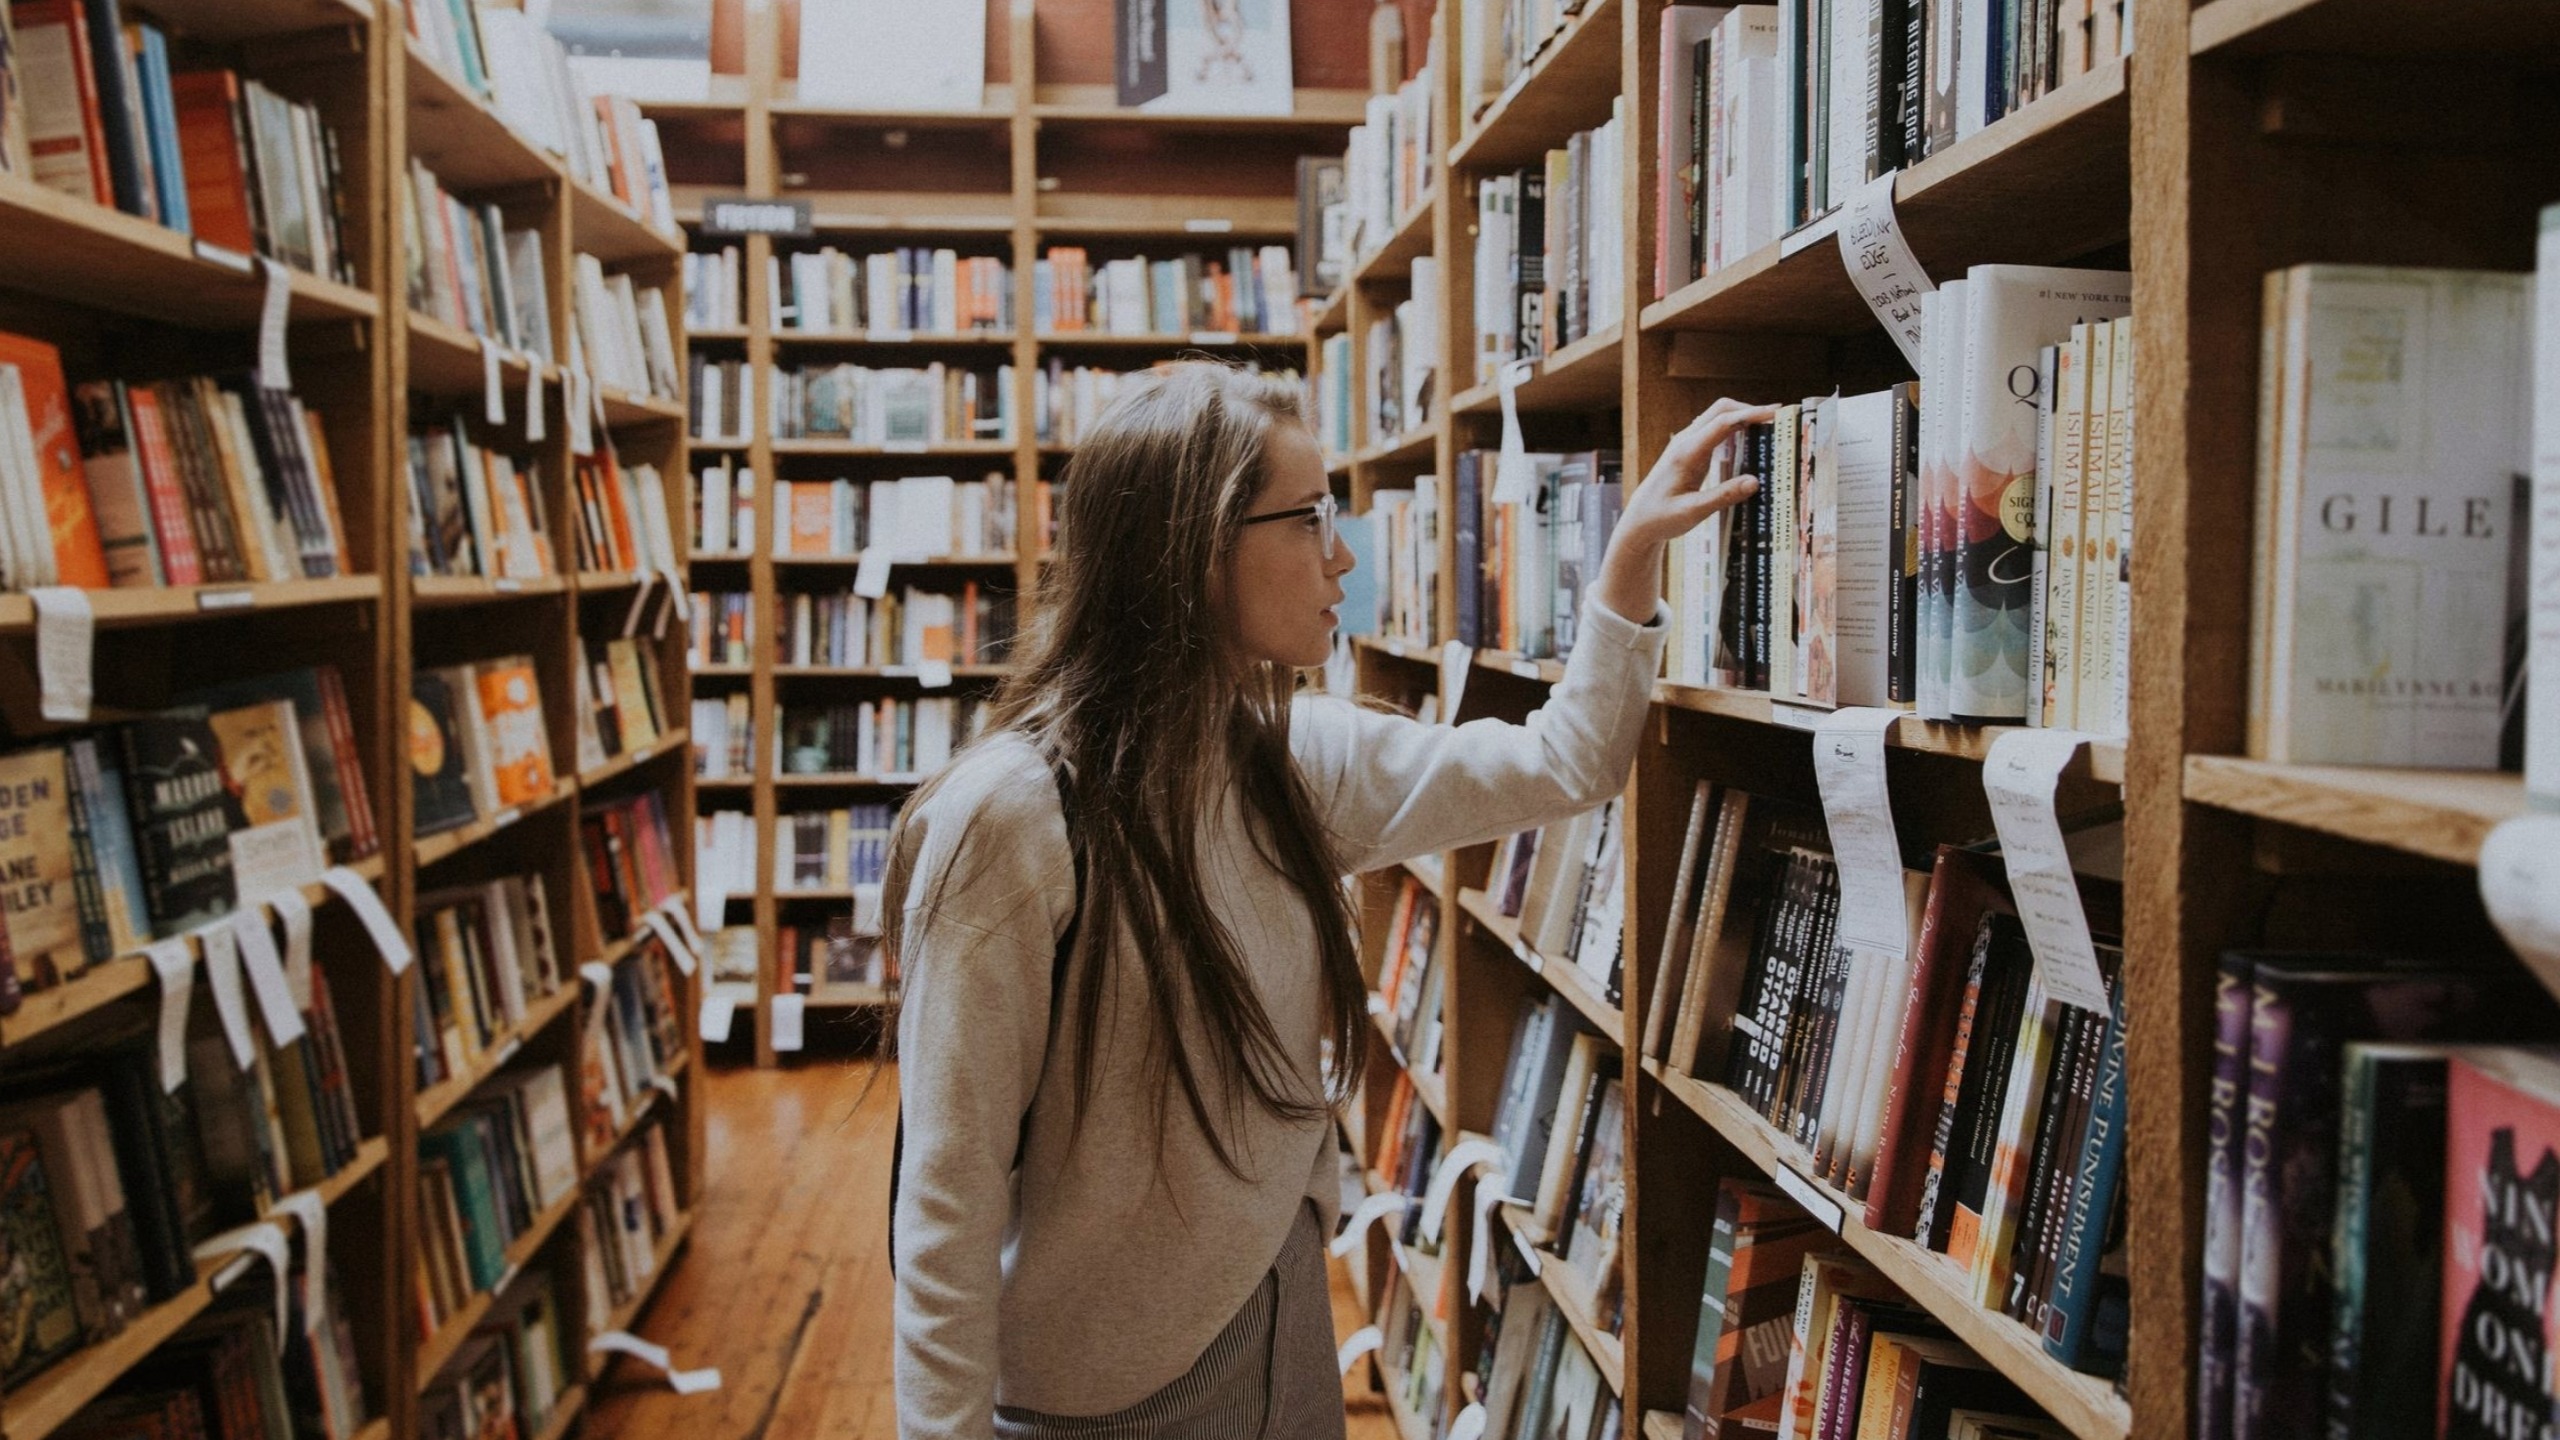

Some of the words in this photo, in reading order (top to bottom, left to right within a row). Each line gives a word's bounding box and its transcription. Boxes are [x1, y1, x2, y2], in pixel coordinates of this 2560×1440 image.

[1749, 24, 1766, 32] THE
[1866, 33, 1879, 113] BLEEDING
[1905, 19, 1920, 102] BLEEDING
[1866, 117, 1878, 157] EDGE
[1904, 105, 1918, 149] EDGE
[2054, 291, 2078, 301] NEW
[2081, 292, 2110, 303] YORK
[1757, 434, 1767, 469] LOVE
[1893, 396, 1905, 486] Monument
[2061, 410, 2081, 518] ISHMAEL
[2106, 408, 2124, 519] ISHMAEL
[2085, 412, 2105, 521] ISHMAEL
[1756, 504, 1766, 535] FAIL
[1783, 498, 1791, 551] LININGS
[1892, 488, 1903, 530] Road
[2320, 492, 2496, 541] GILE
[1738, 552, 1748, 618] MATTHEW
[1756, 553, 1766, 621] MATTHEW
[1890, 568, 1901, 611] Charlie
[2033, 569, 2044, 606] Anna
[2060, 568, 2073, 620] DANIEL
[2083, 572, 2096, 626] DANIEL
[2102, 572, 2115, 626] DANIEL
[1737, 620, 1747, 661] QUICK
[1755, 622, 1765, 665] QUICK
[1890, 612, 1900, 658] Quimby
[2115, 590, 2129, 654] DANIEL
[2029, 611, 2042, 683] Quindlen
[2058, 624, 2070, 675] QUINN
[2081, 631, 2093, 681] QUINN
[2100, 630, 2112, 681] QUINN
[2112, 663, 2127, 722] QUINN
[1810, 891, 1818, 907] THE
[1820, 892, 1829, 911] THE
[1828, 896, 1838, 914] THE
[1802, 912, 1826, 998] IMPERFECTIONISTS
[1810, 916, 1835, 1003] IMPERFECTIONISTS
[1919, 914, 1935, 965] Devil
[1911, 965, 1920, 978] in
[1746, 955, 1778, 1058] OTARED
[1757, 959, 1788, 1064] OTARED
[1766, 964, 1799, 1070] OTARED
[1893, 986, 1920, 1070] Jerusalem
[2055, 1032, 2071, 1081] RAKHA
[2080, 1019, 2091, 1048] WHY
[2091, 1024, 2103, 1054] WHY
[1979, 1094, 1986, 1105] of
[1981, 1069, 1992, 1092] Story
[1992, 1075, 2003, 1098] Story
[2070, 1061, 2082, 1095] CAME
[2081, 1066, 2094, 1101] CAME
[1990, 1100, 1997, 1112] of
[2041, 1113, 2054, 1134] the
[1968, 1112, 1984, 1159] Childhood
[1978, 1118, 1994, 1164] Childhood
[2026, 1136, 2050, 1229] CROCODILES
[2048, 1167, 2061, 1205] MARY
[2059, 1175, 2072, 1212] MARY
[2057, 1114, 2110, 1299] PUNISHMENT
[1806, 1271, 1814, 1297] AYN
[1870, 1343, 1885, 1382] KNOW
[1883, 1359, 1898, 1397] KNOW
